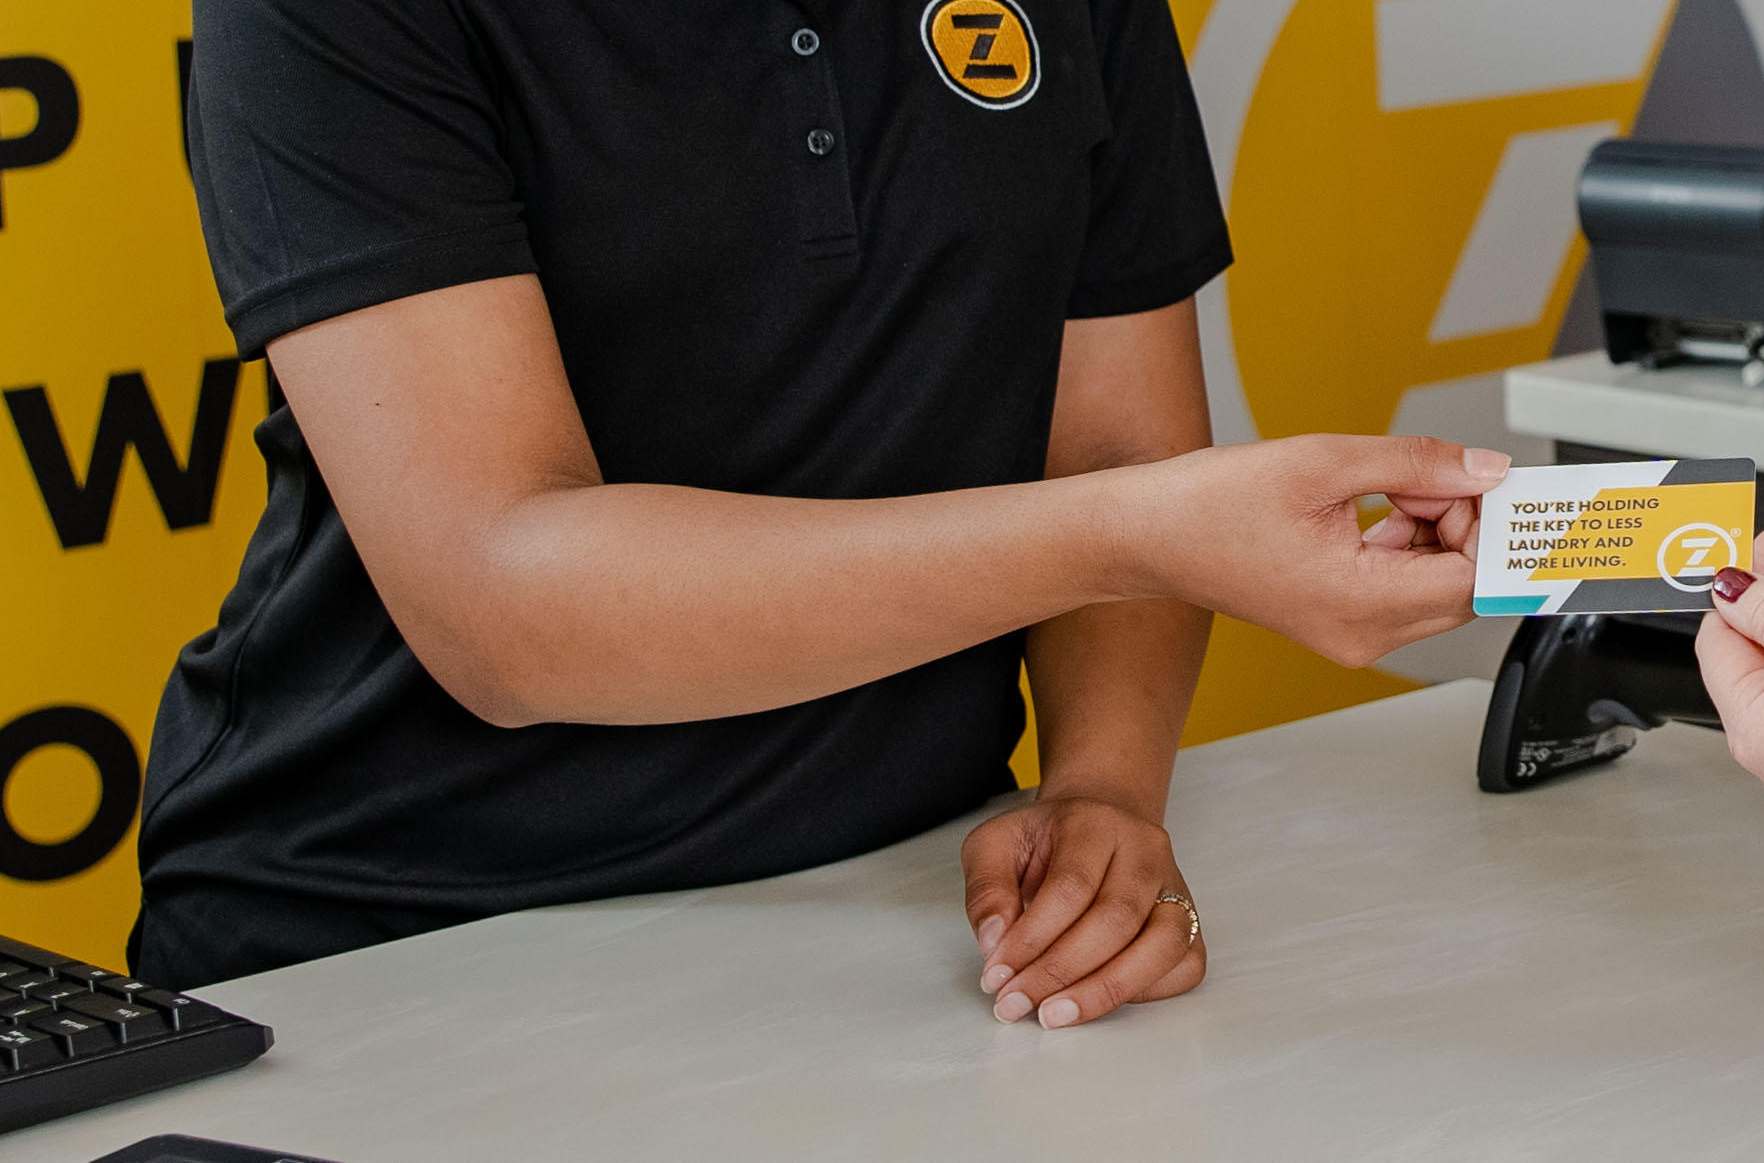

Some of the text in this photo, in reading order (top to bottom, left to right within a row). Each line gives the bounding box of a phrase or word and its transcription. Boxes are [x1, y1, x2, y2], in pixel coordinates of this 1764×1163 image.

[1512, 498, 1660, 514] YOU'RE HOLDING
[1509, 517, 1643, 533] THE KEY TO LESS
[1508, 536, 1633, 551] LAUNDRY AND
[1507, 555, 1627, 570] MORE LIVING.
